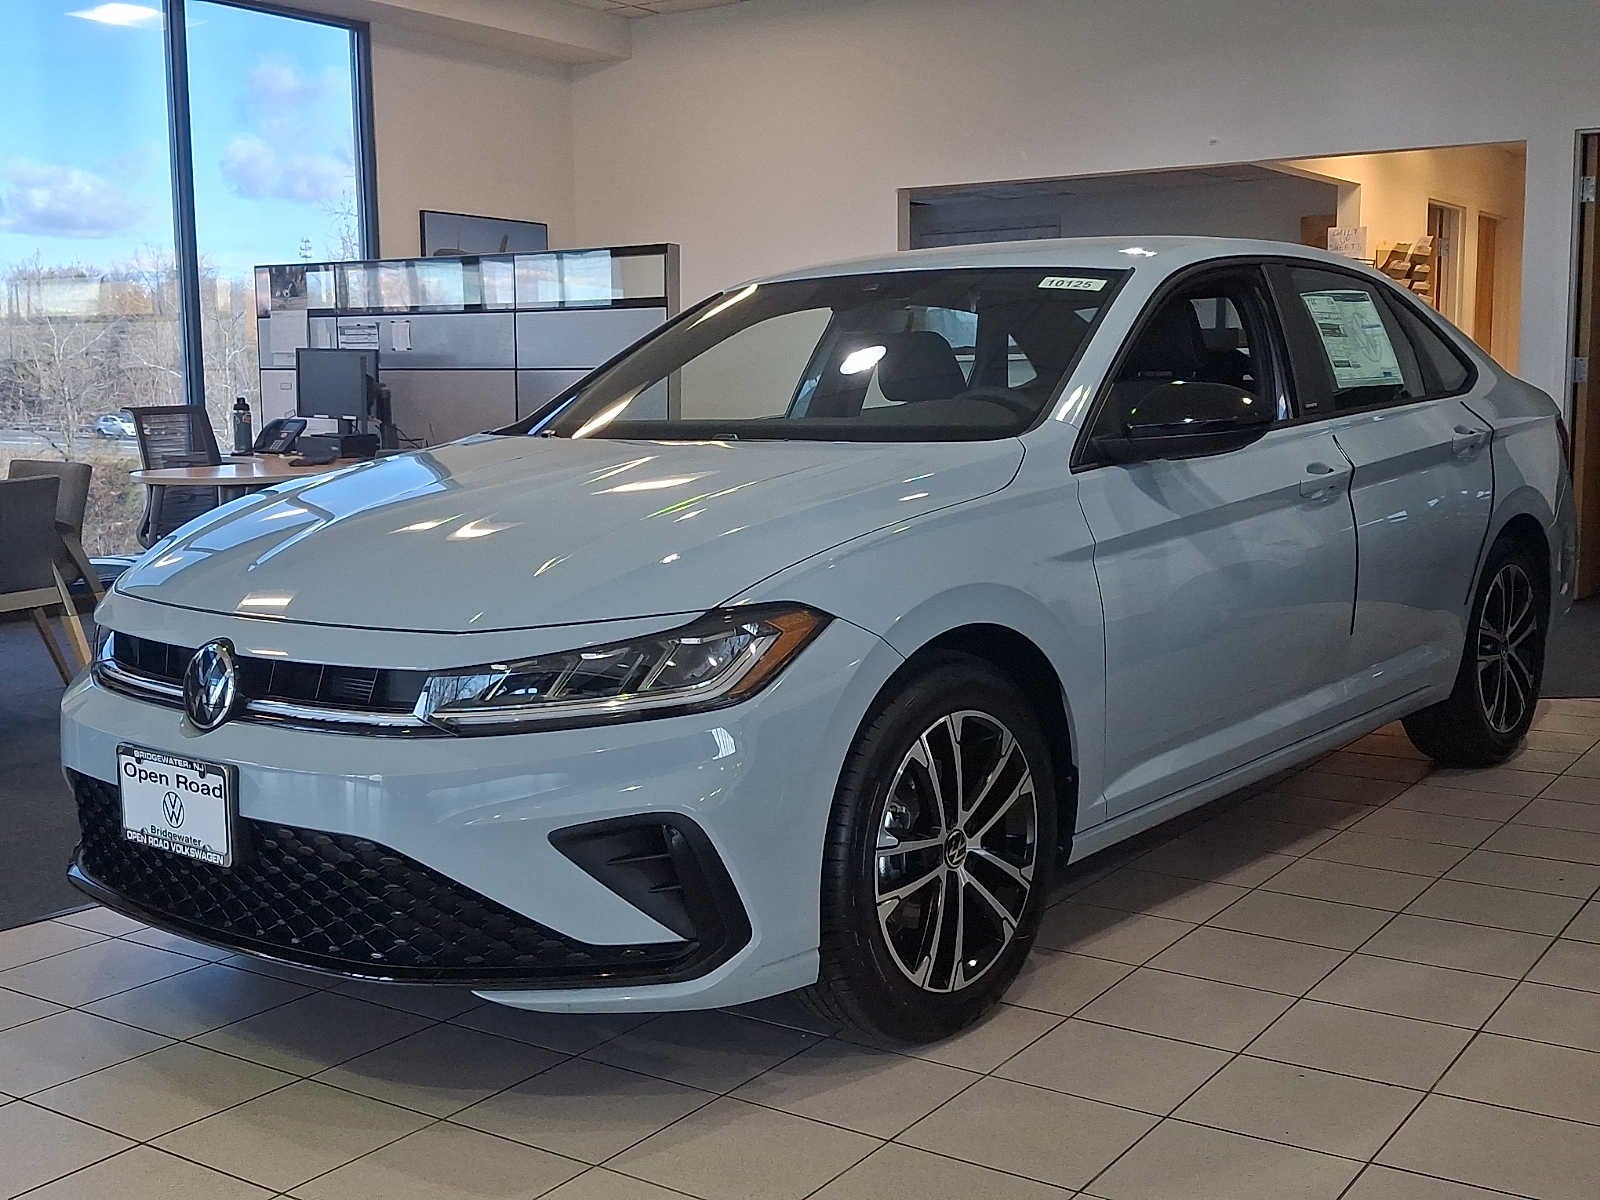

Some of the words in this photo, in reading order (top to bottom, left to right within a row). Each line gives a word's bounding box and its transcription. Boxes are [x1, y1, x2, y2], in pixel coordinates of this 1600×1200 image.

[1048, 280, 1093, 288] 10125
[193, 762, 204, 772] NJ
[123, 762, 169, 786] Open
[175, 774, 223, 799] Road
[150, 825, 203, 847] Bridgewater
[126, 830, 147, 845] OPEN
[148, 836, 170, 850] ROAD
[170, 841, 223, 865] VOLKSWAGEN
